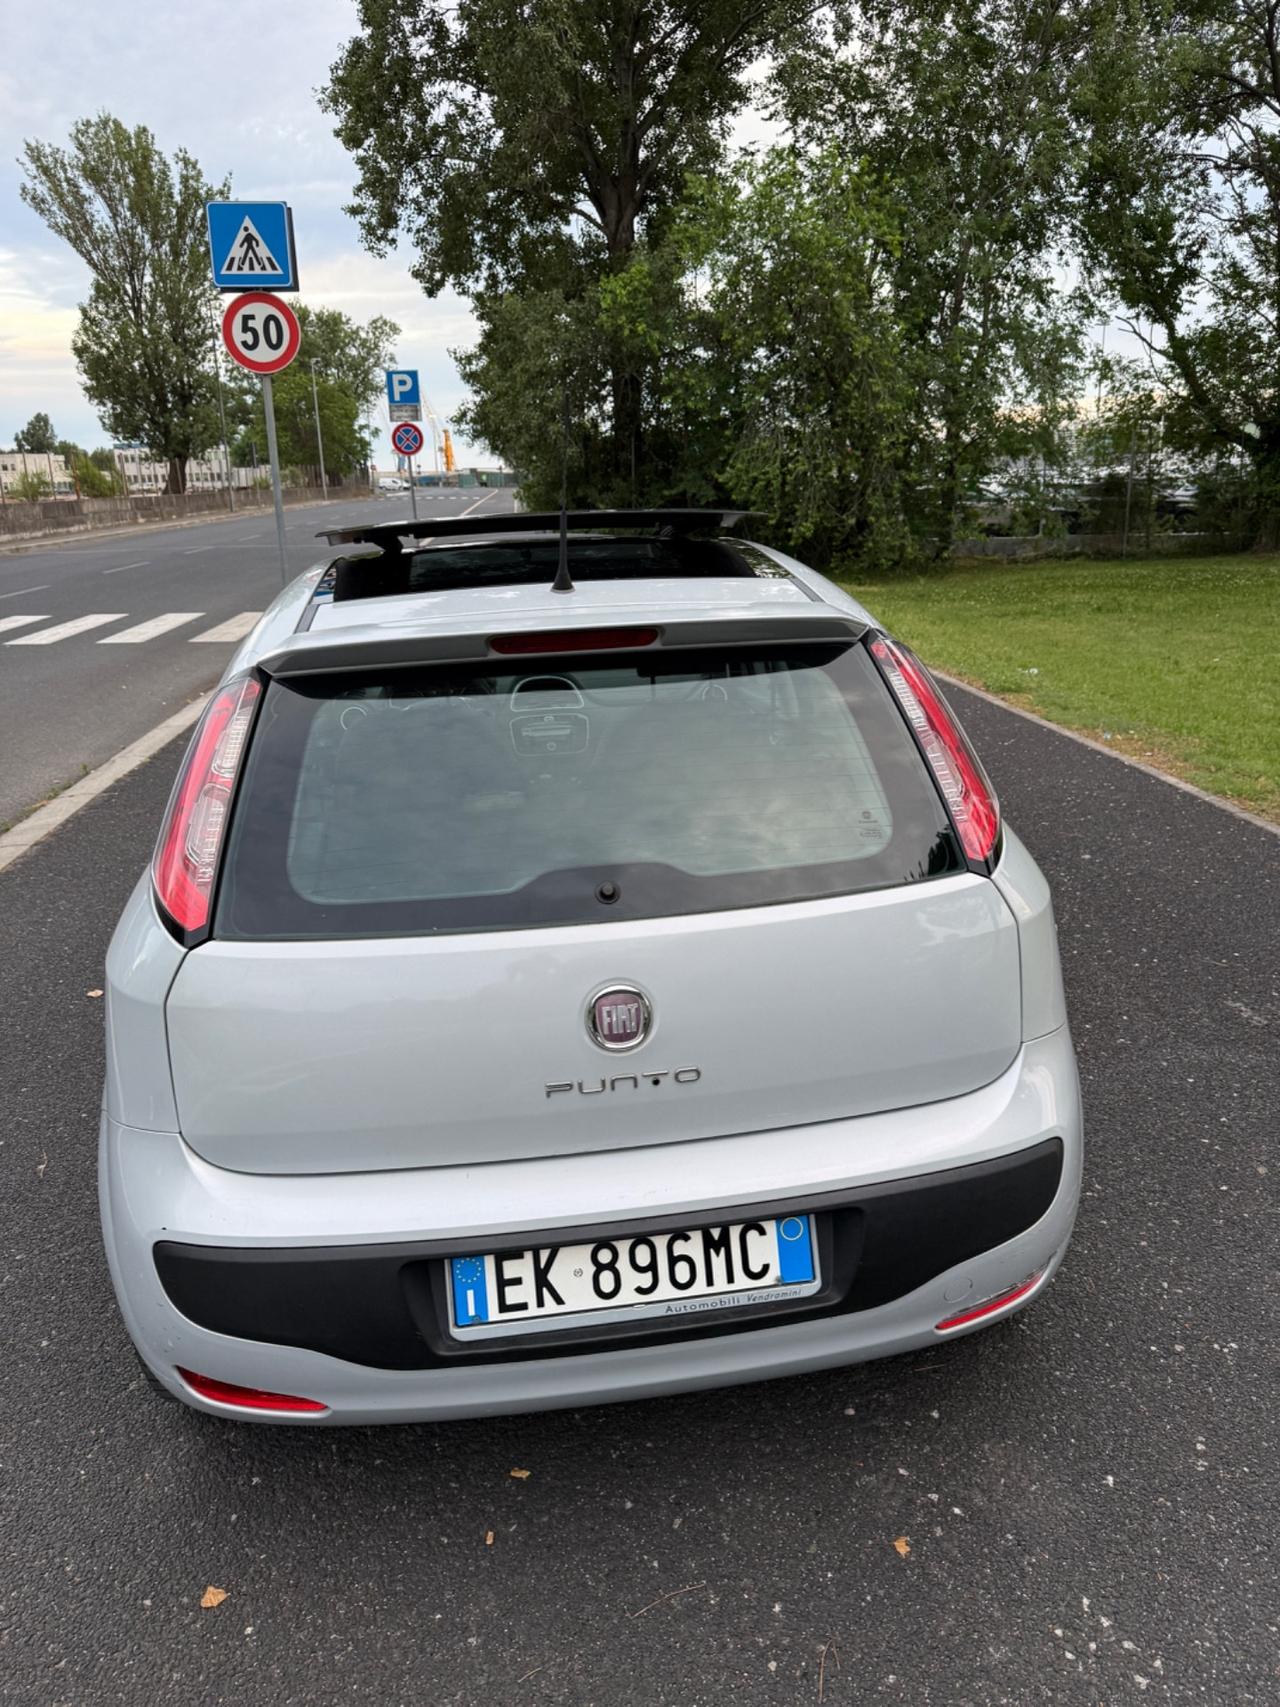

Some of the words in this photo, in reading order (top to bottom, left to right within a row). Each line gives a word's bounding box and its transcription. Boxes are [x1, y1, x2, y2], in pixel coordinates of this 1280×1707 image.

[240, 314, 284, 351] 50
[392, 373, 413, 401] P
[601, 1003, 639, 1034] FIAT
[545, 1066, 701, 1098] PUNTO
[494, 1248, 566, 1314] EK
[590, 1222, 771, 1301] 896MC
[466, 1289, 476, 1317] I
[665, 1297, 740, 1314] Automobili
[746, 1289, 802, 1303] Vendramini
